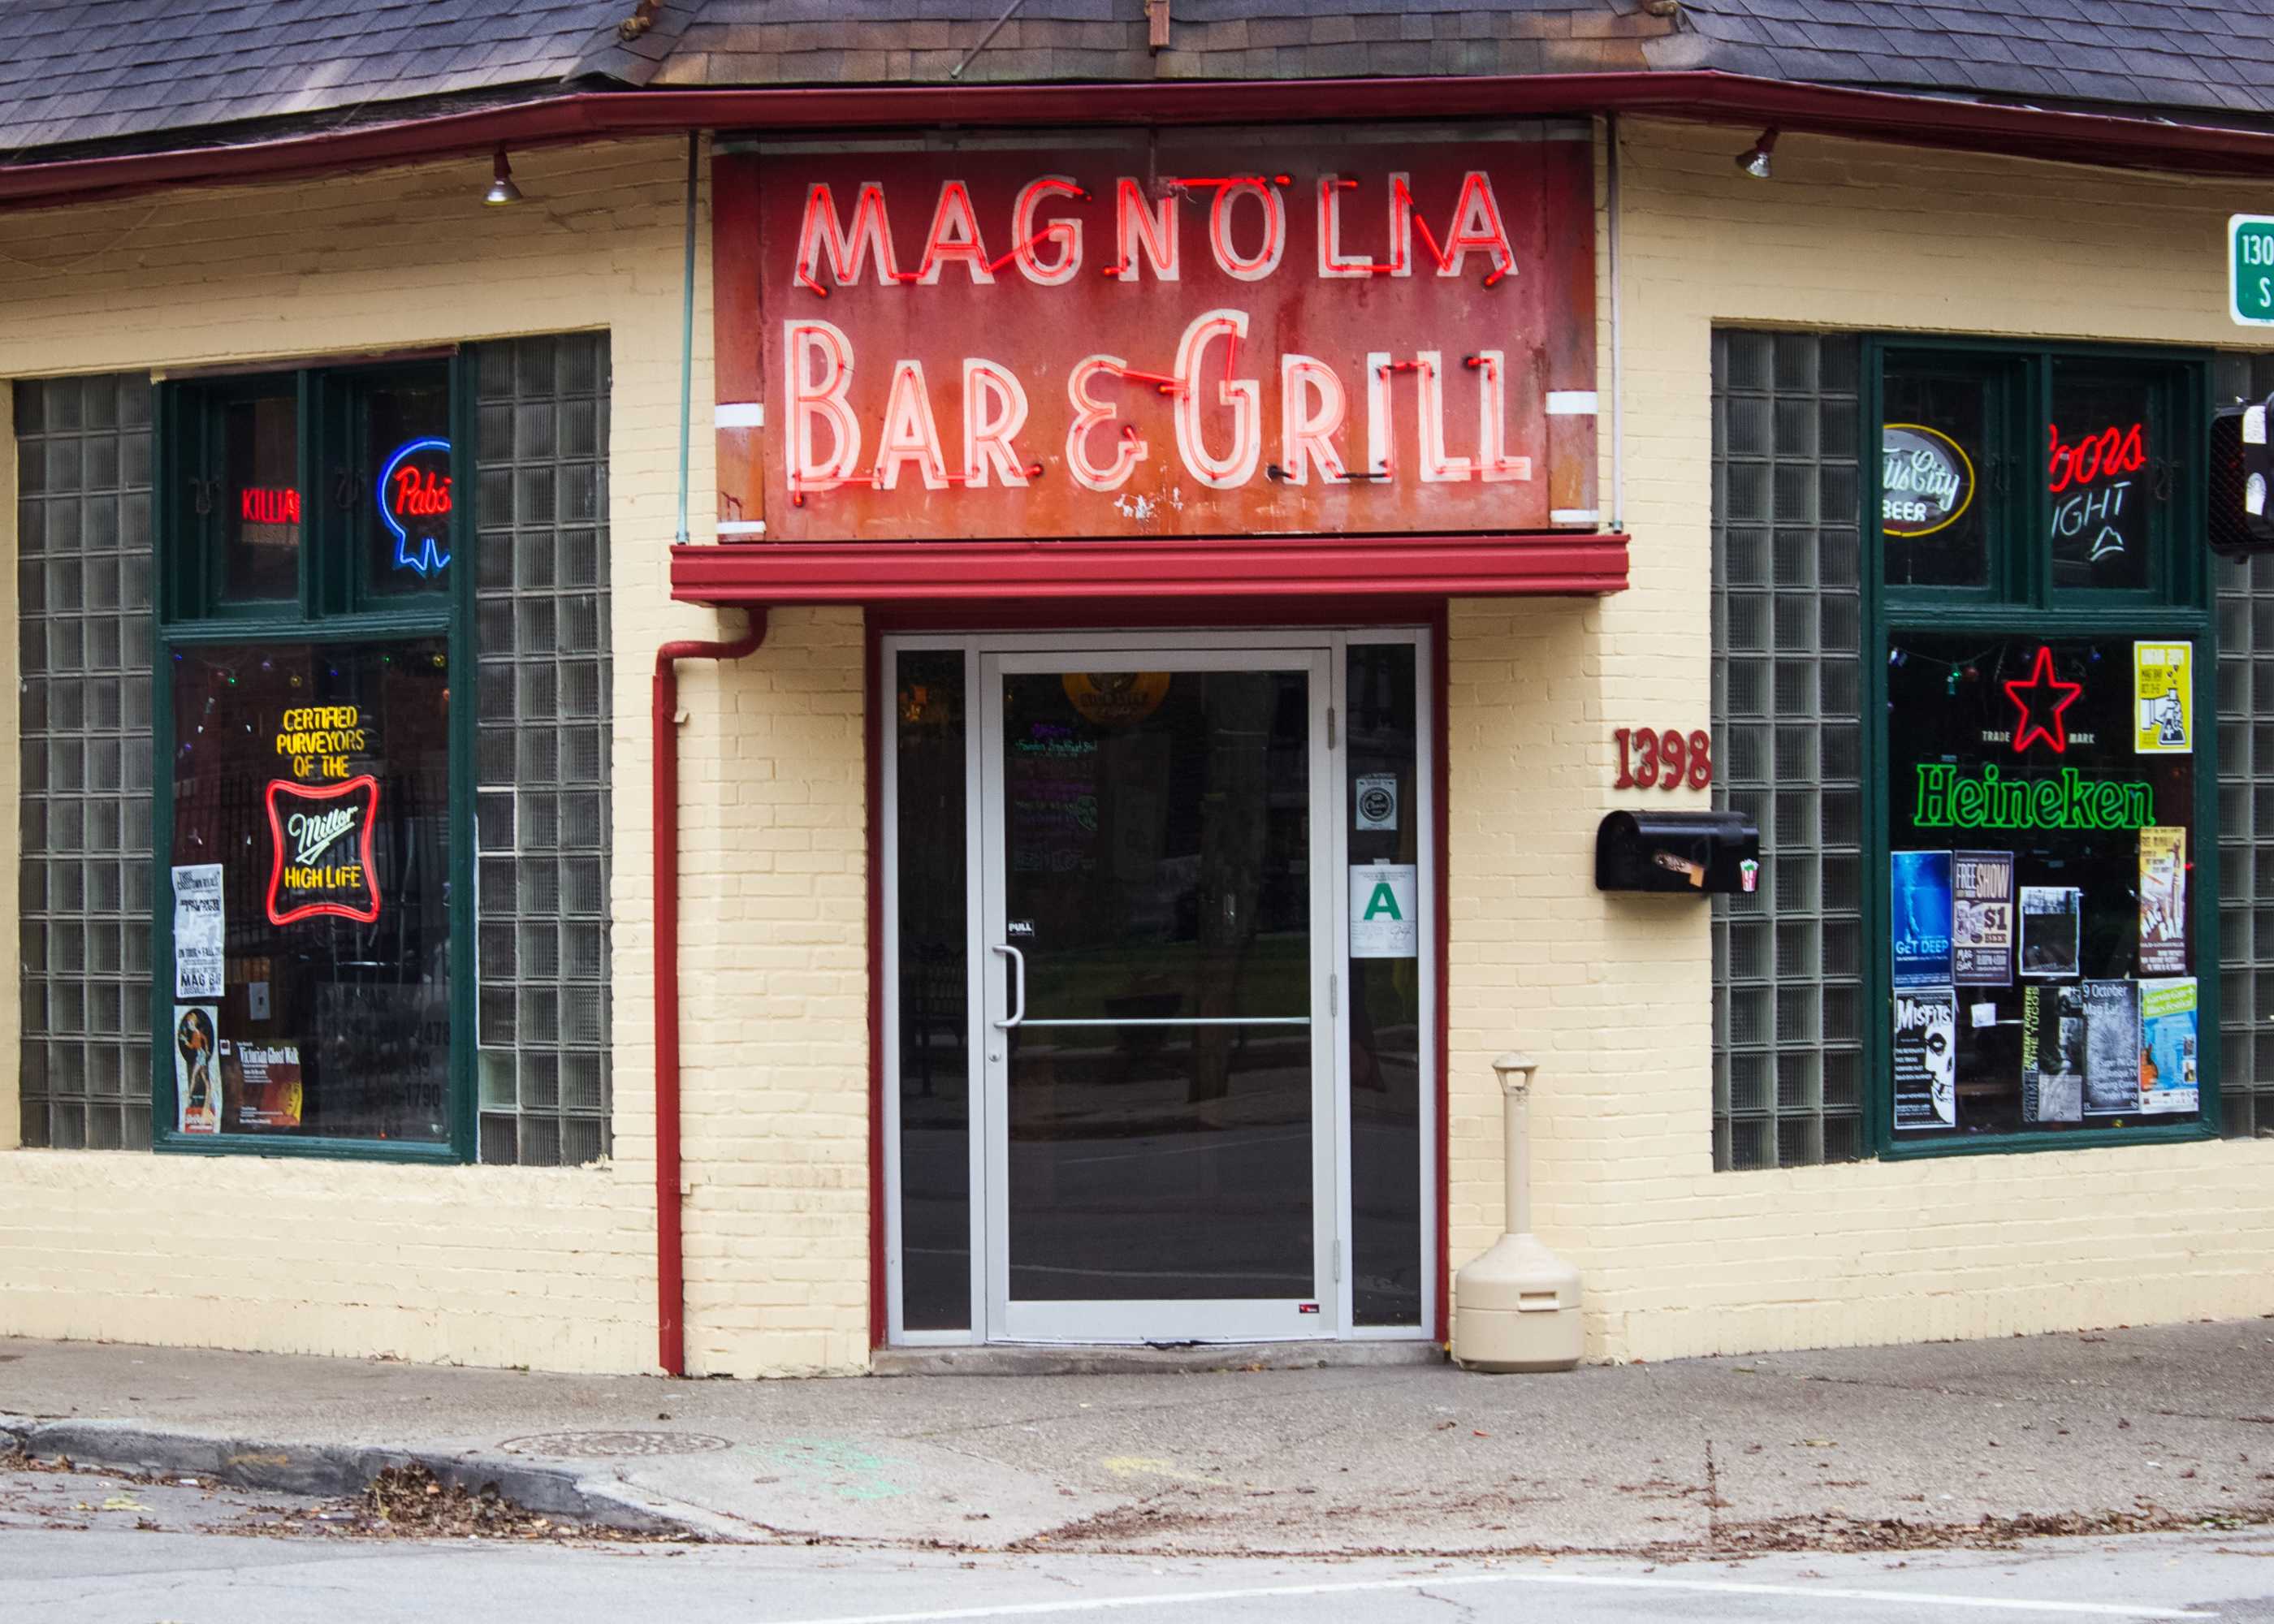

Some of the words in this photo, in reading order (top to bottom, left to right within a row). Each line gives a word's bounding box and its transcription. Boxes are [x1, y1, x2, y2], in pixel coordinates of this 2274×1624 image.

[793, 171, 1519, 287] MAGNOLIA
[2242, 235, 2274, 266] 130
[784, 319, 1031, 491] BAR
[1066, 353, 1148, 492] &
[1174, 309, 1532, 488] GRILL
[2049, 423, 2145, 492] oors
[242, 487, 300, 524] KILLIA
[395, 465, 452, 516] Pabs
[1883, 499, 1927, 522] BEER
[2051, 481, 2131, 538] IGHT
[283, 706, 357, 732] CERTIFIED
[277, 729, 365, 754] PURVEYORS
[1982, 731, 2011, 742] TRADE
[2068, 732, 2095, 744] MARK
[293, 754, 314, 778] OF
[322, 754, 350, 778] THE
[1614, 727, 1713, 791] 1398
[1913, 763, 2157, 830] Heineken
[287, 806, 359, 857] Miller
[285, 866, 323, 889] HIGH
[326, 864, 362, 889] LIFE
[1956, 863, 1977, 890] FREE
[1976, 863, 2010, 899] SHOW
[1363, 883, 1403, 921] A
[1008, 922, 1033, 932] PULL
[1984, 905, 2008, 931] $1
[1921, 938, 1949, 954] DEEP
[180, 974, 205, 987] MAG
[2091, 983, 2128, 999] October
